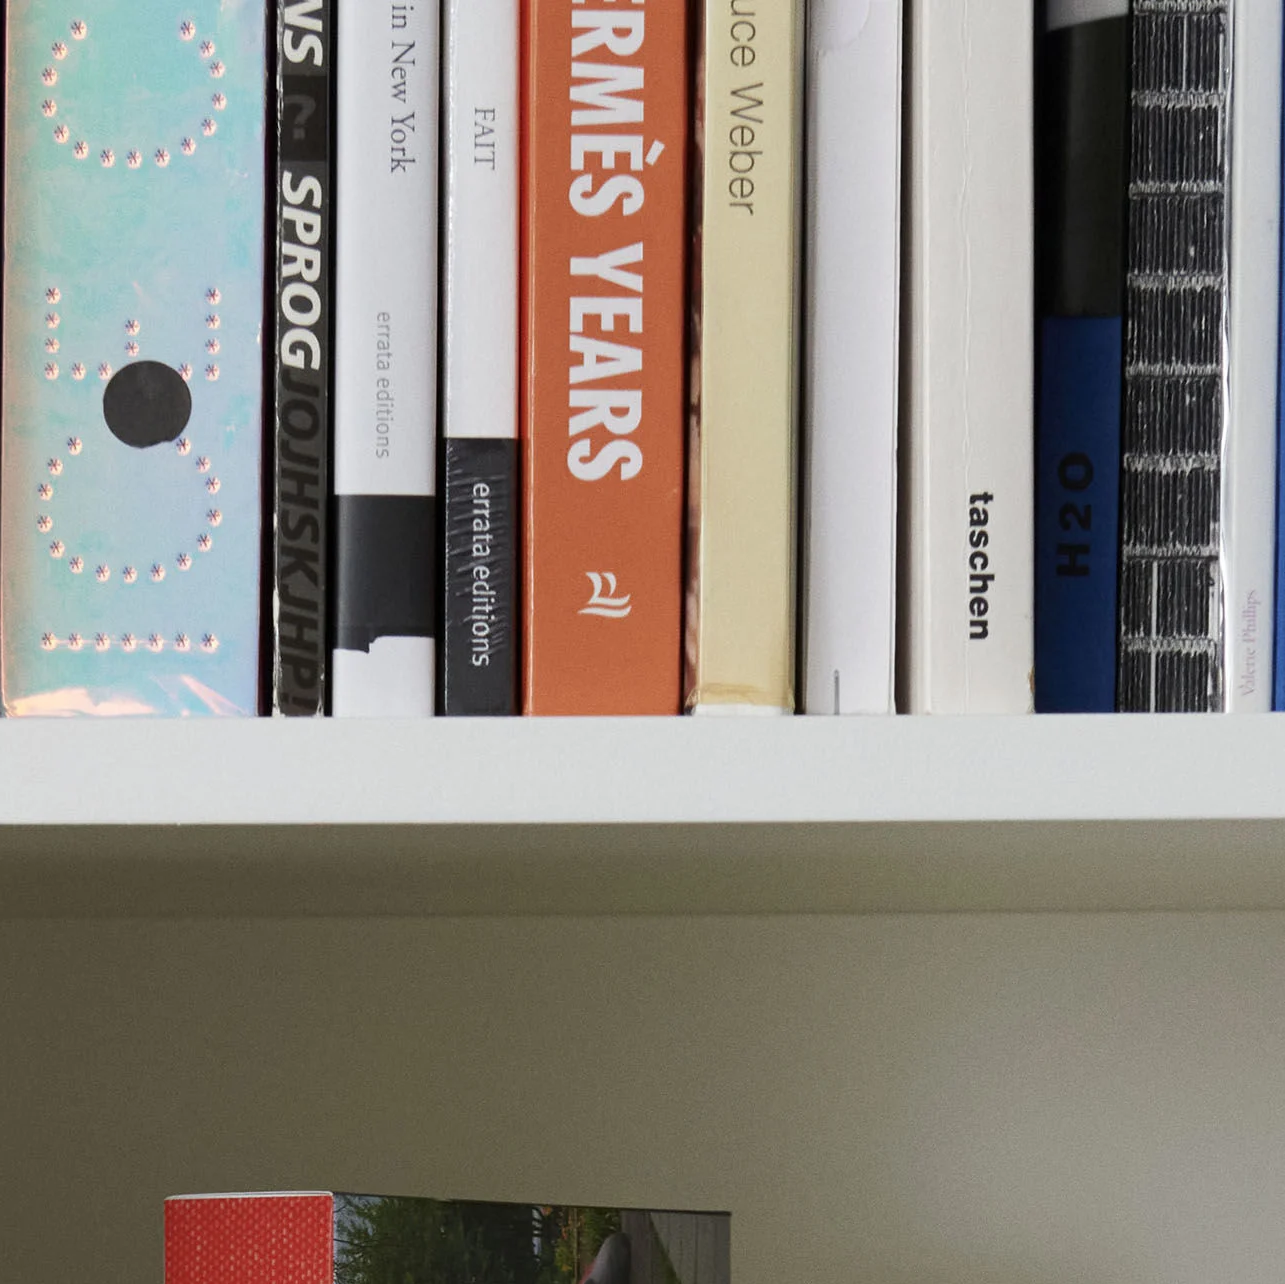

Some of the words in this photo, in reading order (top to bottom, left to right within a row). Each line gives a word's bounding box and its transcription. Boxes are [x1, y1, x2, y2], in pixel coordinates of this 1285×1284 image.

[391, 5, 415, 29] in
[391, 40, 416, 103] New
[390, 111, 416, 173] York
[474, 106, 498, 170] FAIT
[728, 82, 764, 215] Weber
[280, 170, 323, 369] SPROG
[376, 311, 393, 371] errata
[566, 242, 644, 481] YEARS
[375, 377, 395, 459] editions
[471, 483, 494, 557] errata
[1055, 452, 1095, 577] H2O
[968, 493, 996, 639] taschen
[467, 562, 497, 666] editions
